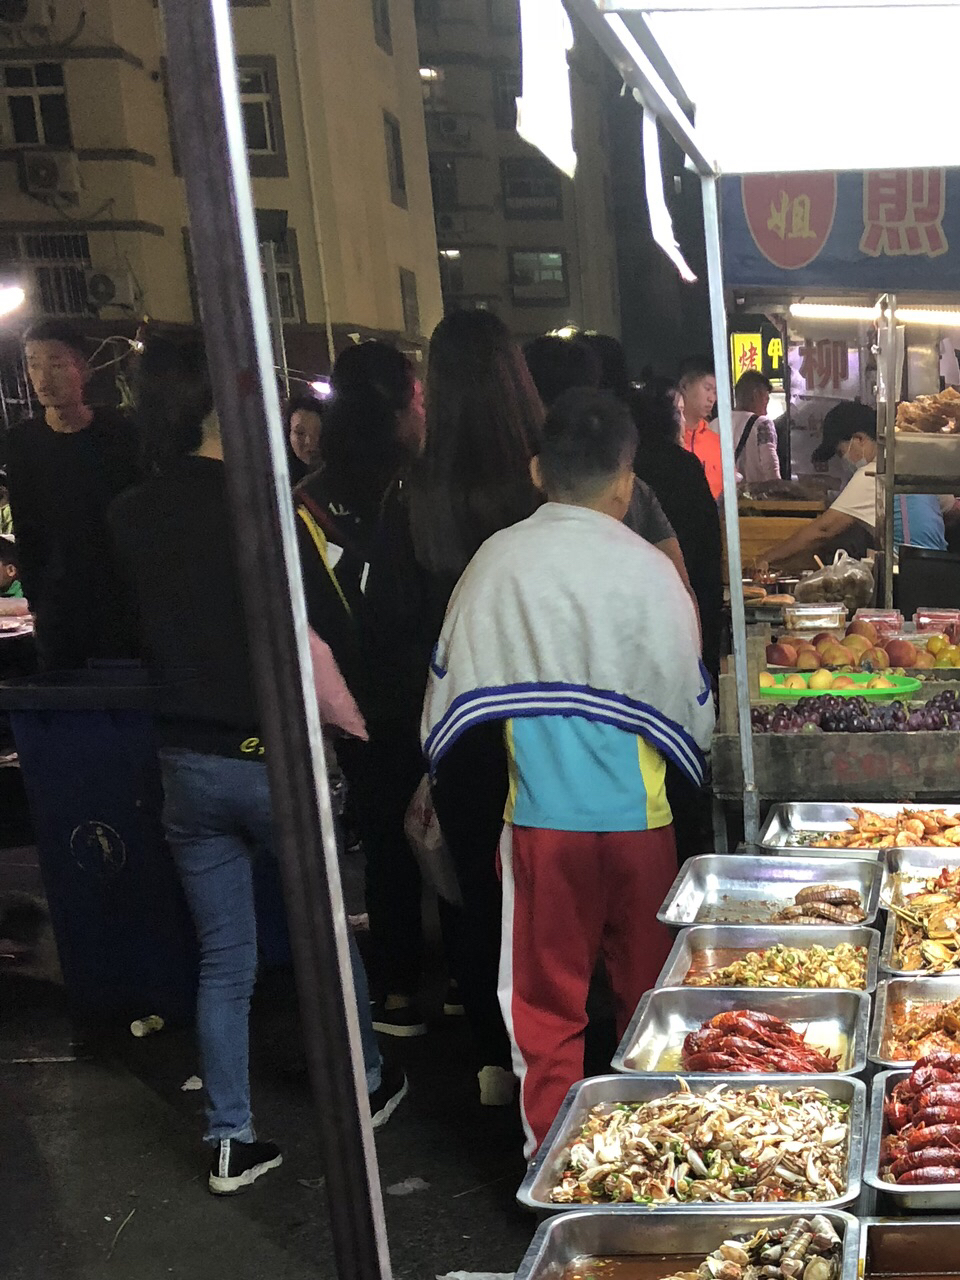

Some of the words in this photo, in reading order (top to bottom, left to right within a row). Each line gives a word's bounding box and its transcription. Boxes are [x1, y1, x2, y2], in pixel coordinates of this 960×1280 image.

[766, 189, 817, 240] 姐
[739, 341, 759, 372] 烤
[798, 338, 849, 390] 柳
